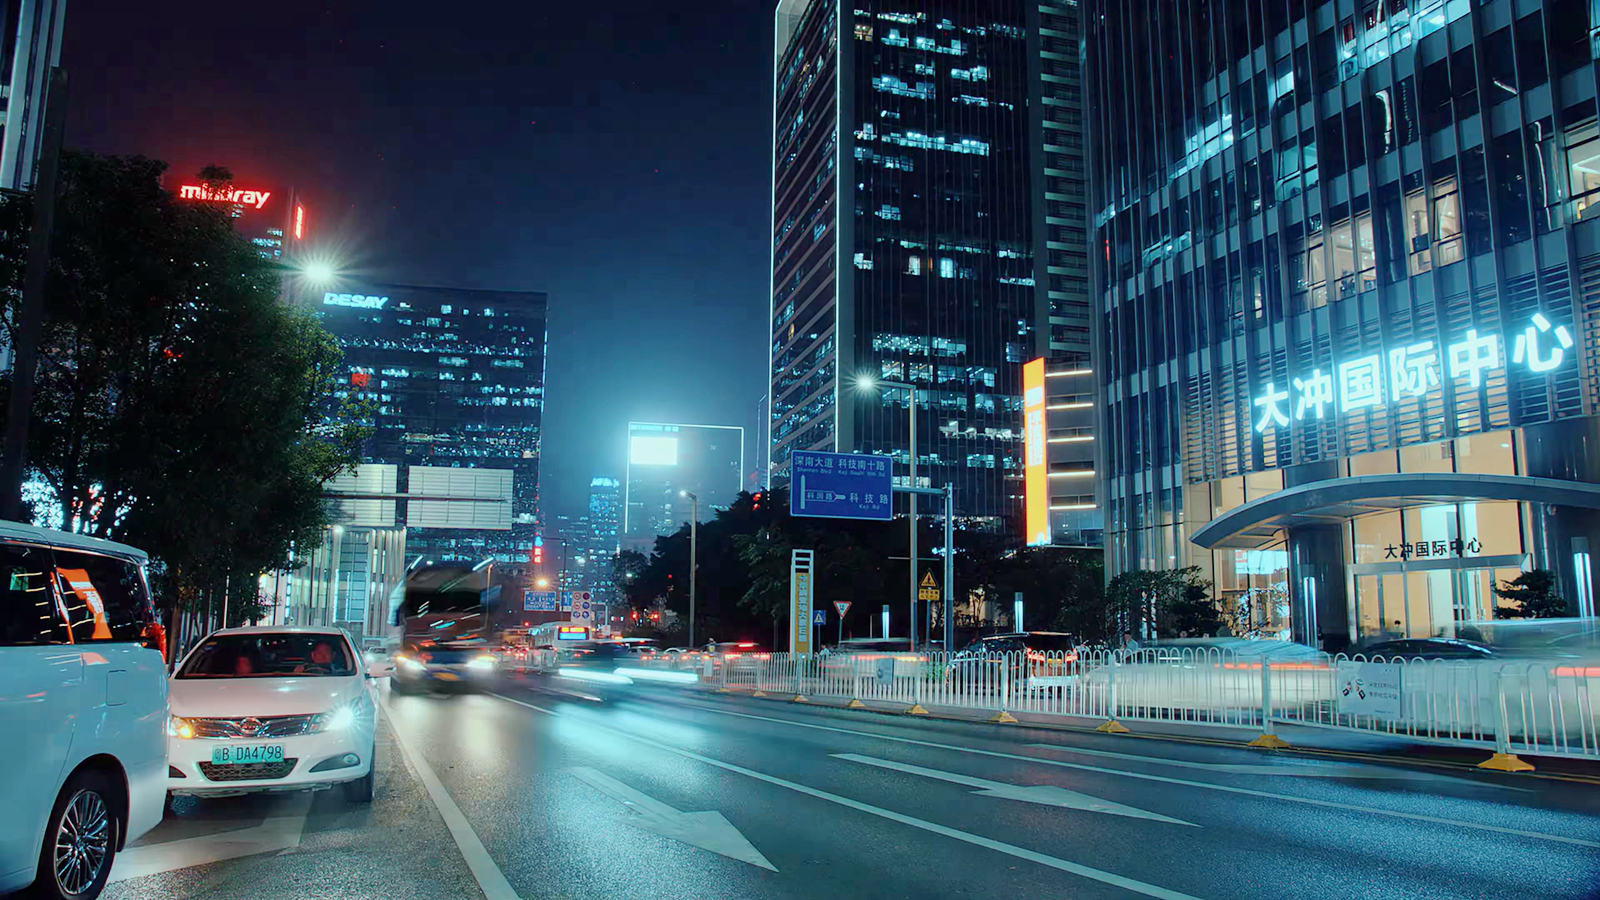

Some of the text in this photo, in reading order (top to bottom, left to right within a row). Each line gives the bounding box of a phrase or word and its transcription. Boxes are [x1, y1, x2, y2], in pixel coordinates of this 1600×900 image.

[323, 292, 388, 310] DESAY
[1254, 313, 1573, 433] 大冲国际中心
[795, 456, 885, 471] 深南大道 科技南十路
[850, 492, 888, 504] 科技路
[1384, 537, 1482, 559] 大冲国际中心
[237, 746, 282, 760] DA4798
